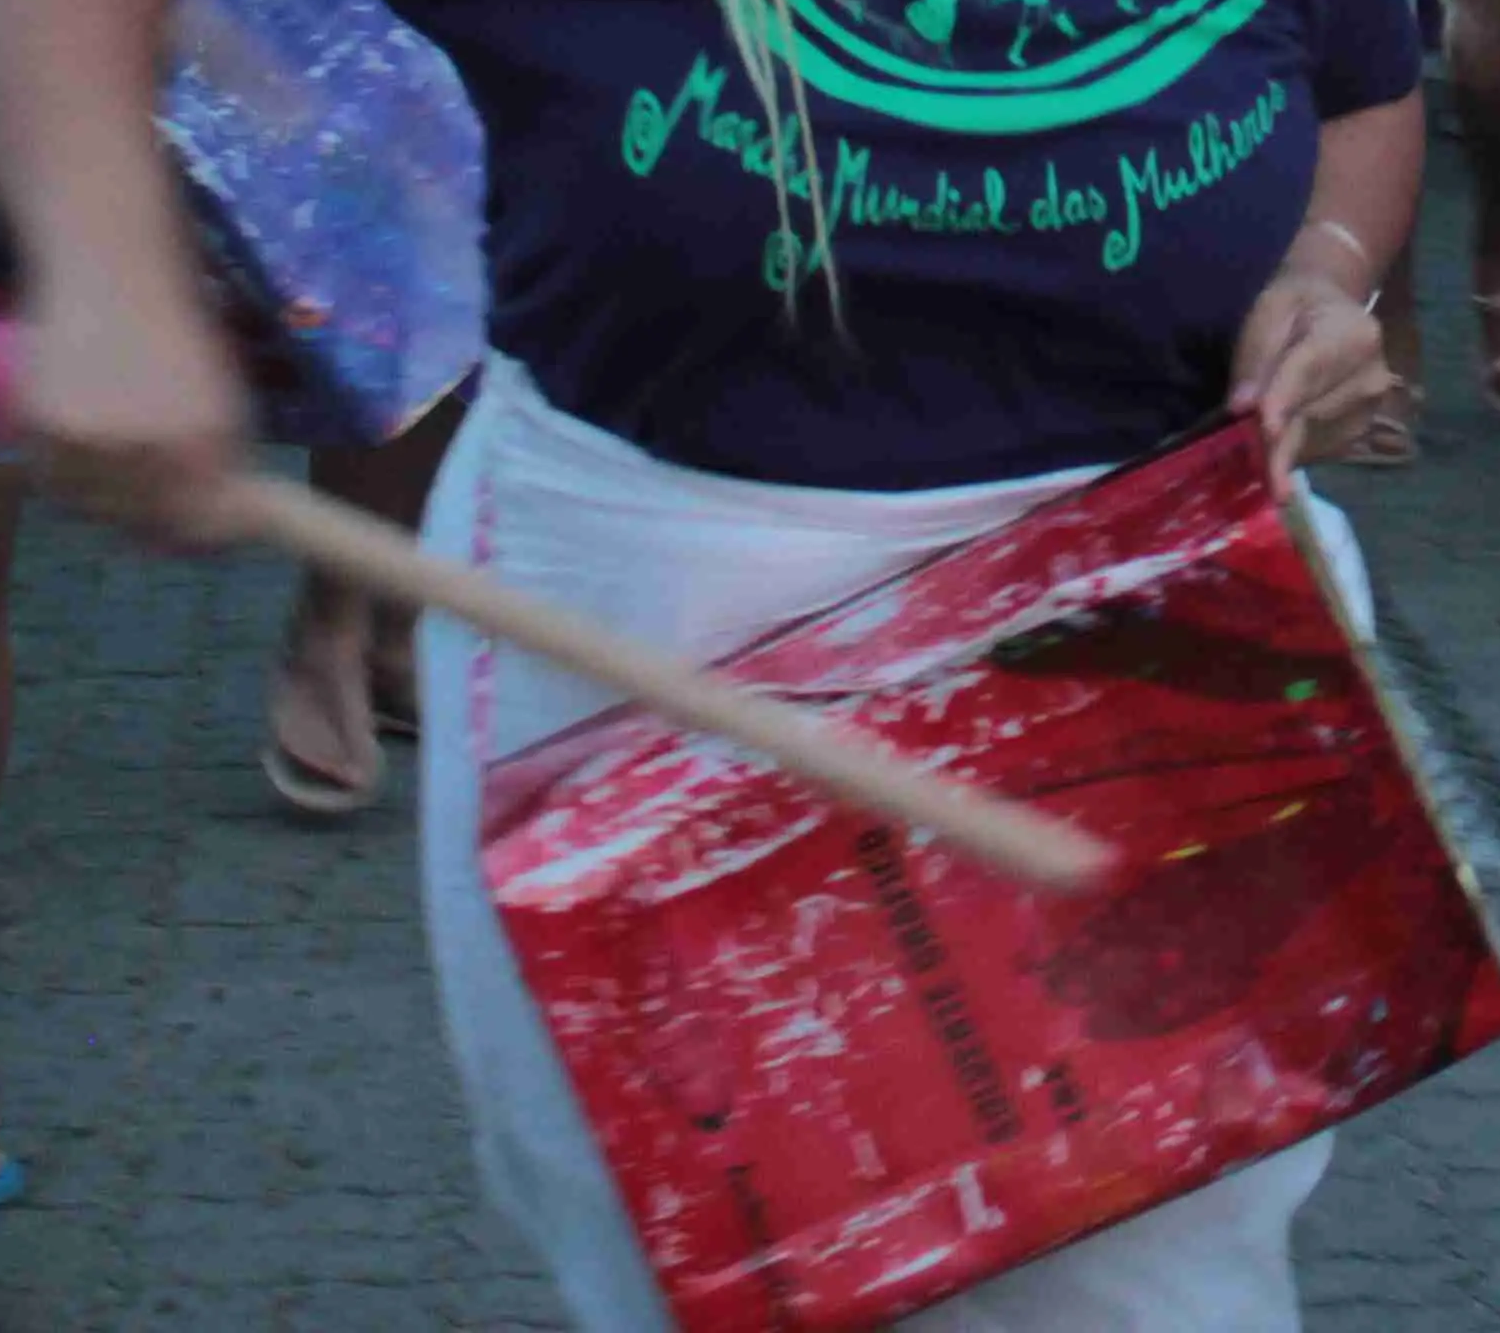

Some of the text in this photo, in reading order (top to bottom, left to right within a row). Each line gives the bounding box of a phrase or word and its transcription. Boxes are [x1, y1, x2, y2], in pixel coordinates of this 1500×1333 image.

[763, 137, 1022, 290] Mundial
[1030, 161, 1107, 229] das
[1102, 77, 1287, 271] Mulheres
